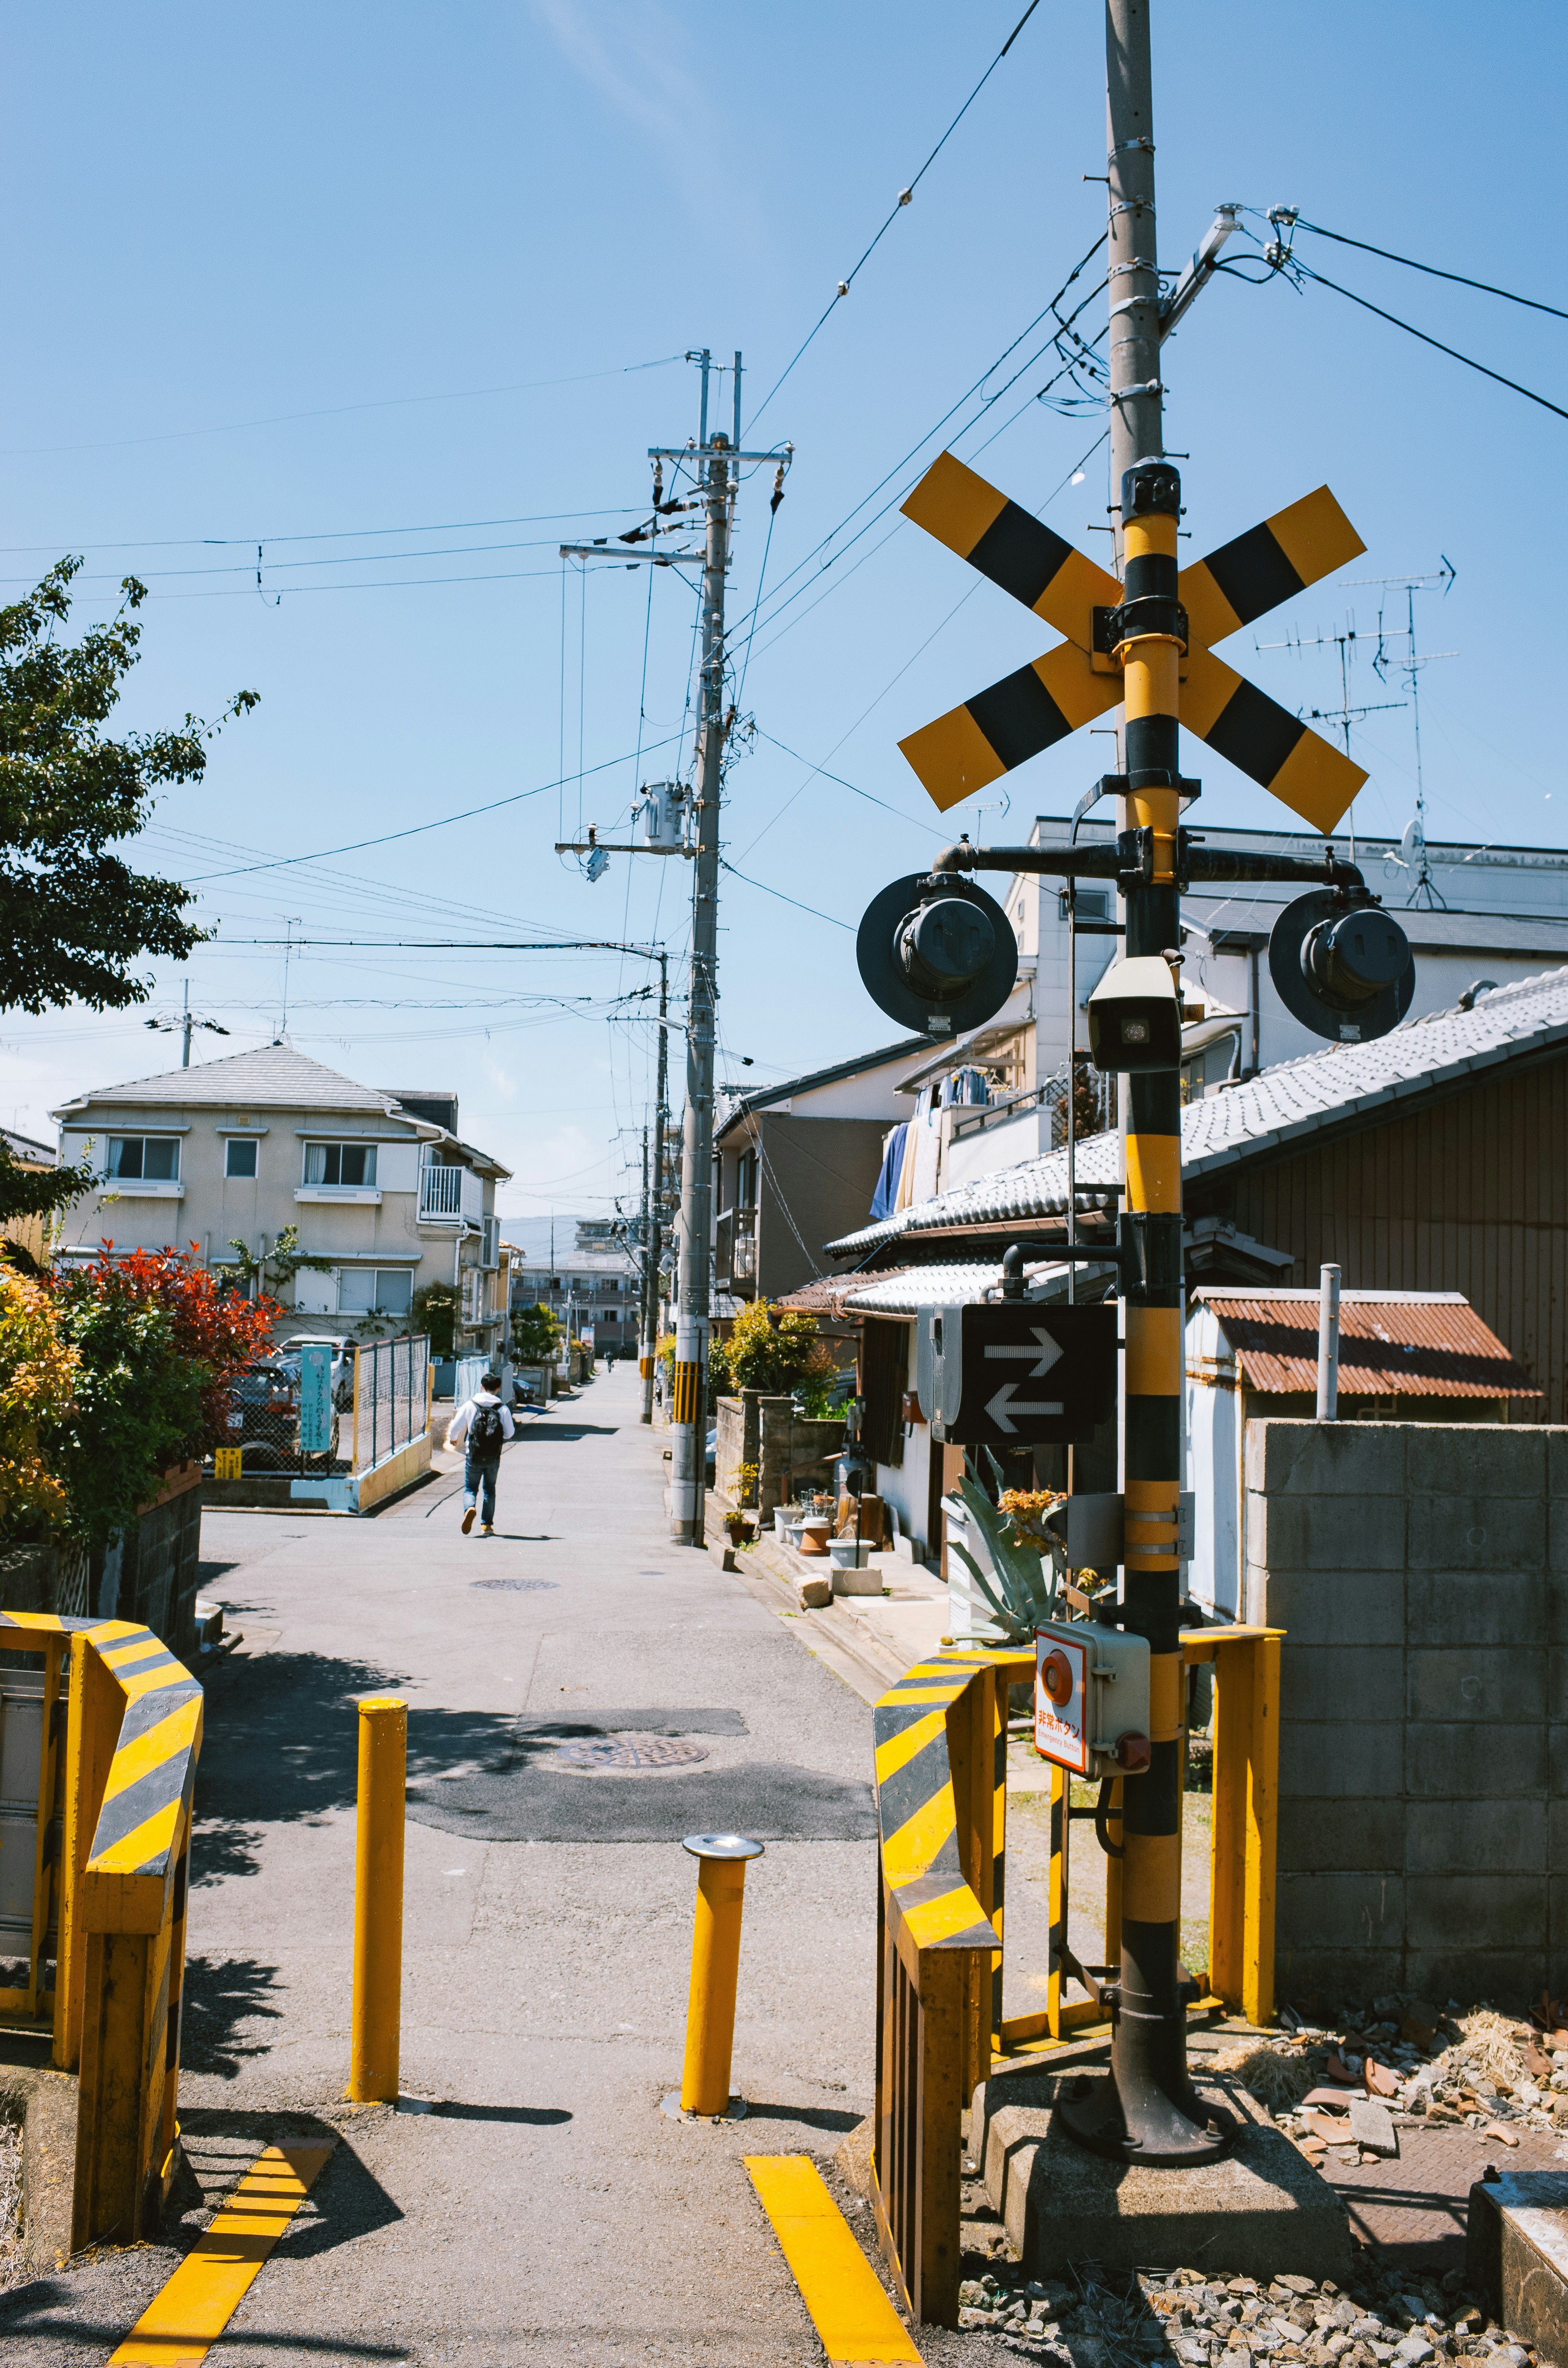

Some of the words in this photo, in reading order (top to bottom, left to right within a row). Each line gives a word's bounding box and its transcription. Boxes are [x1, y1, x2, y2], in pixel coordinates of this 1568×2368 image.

[1039, 1709, 1079, 1739] 非常ボタン
[1038, 1729, 1063, 1748] Emergency
[1064, 1740, 1079, 1753] Button
